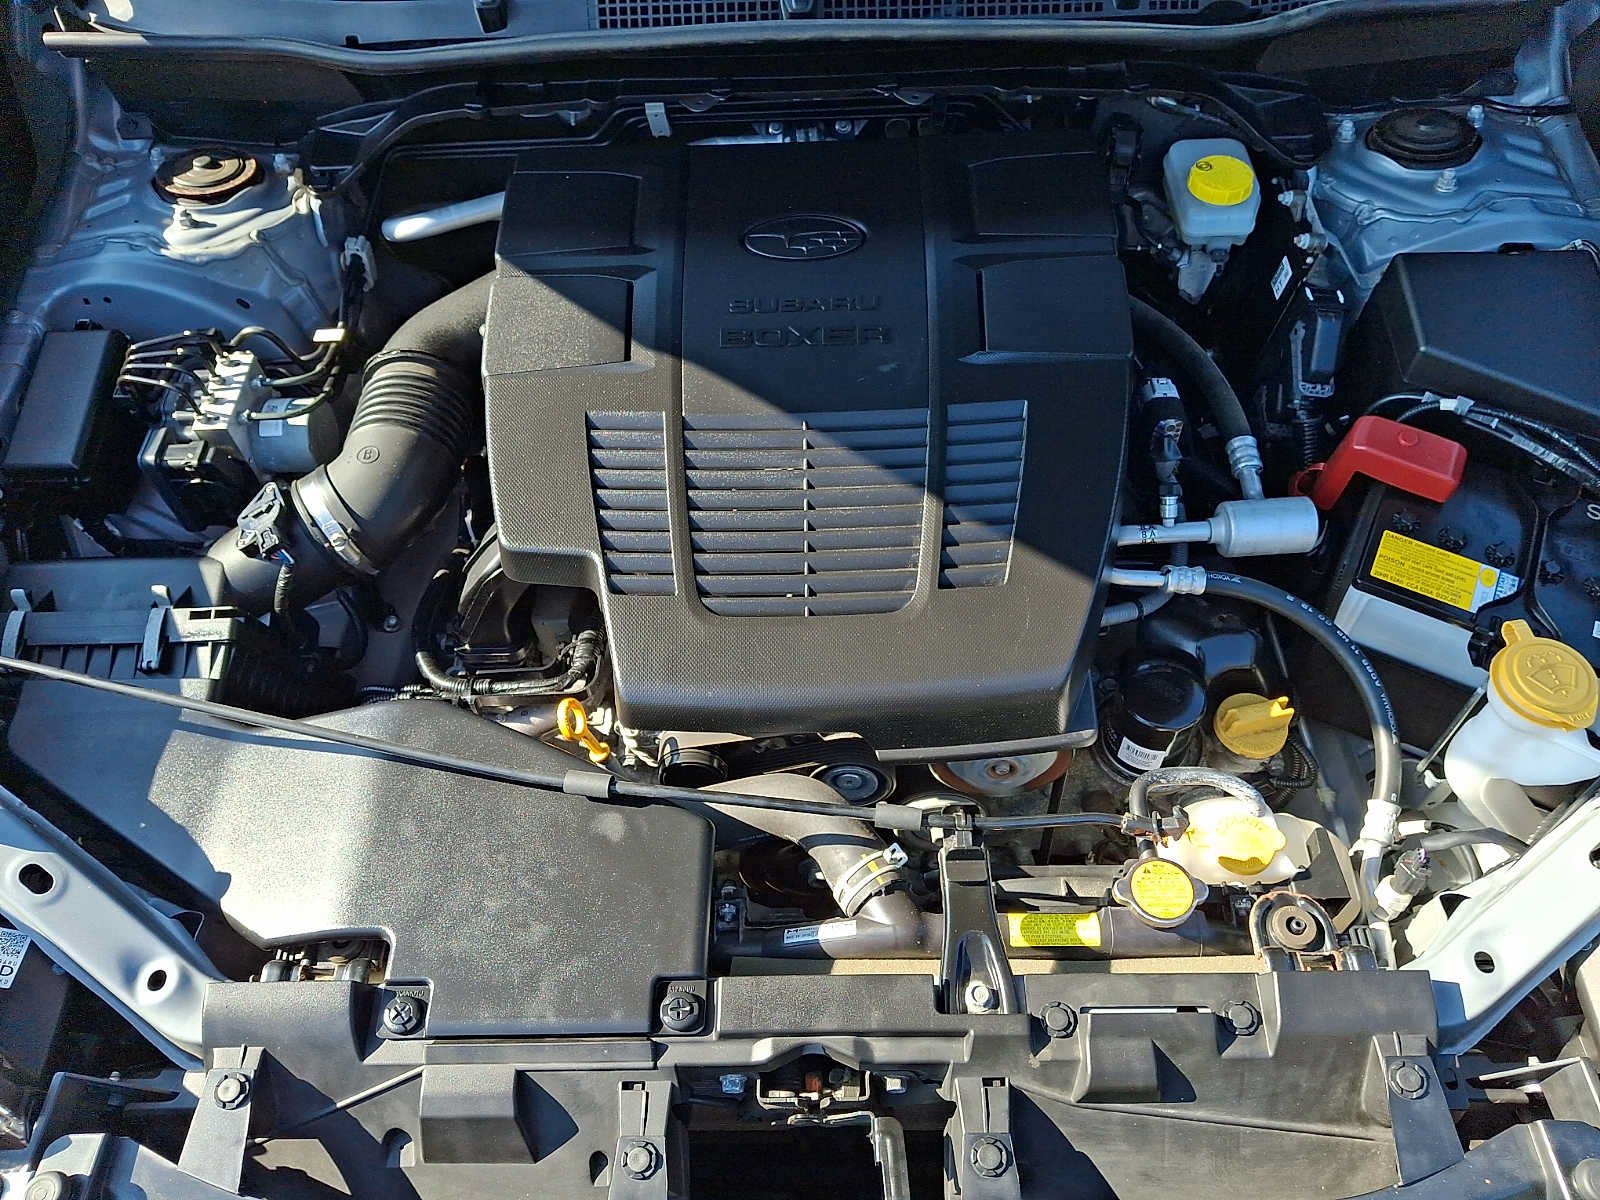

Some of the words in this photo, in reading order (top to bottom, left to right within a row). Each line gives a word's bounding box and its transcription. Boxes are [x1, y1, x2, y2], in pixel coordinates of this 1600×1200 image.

[728, 297, 880, 313] SUBARU
[719, 326, 890, 349] BOXER
[1385, 531, 1414, 546] DANGER
[1377, 552, 1406, 567] POISON
